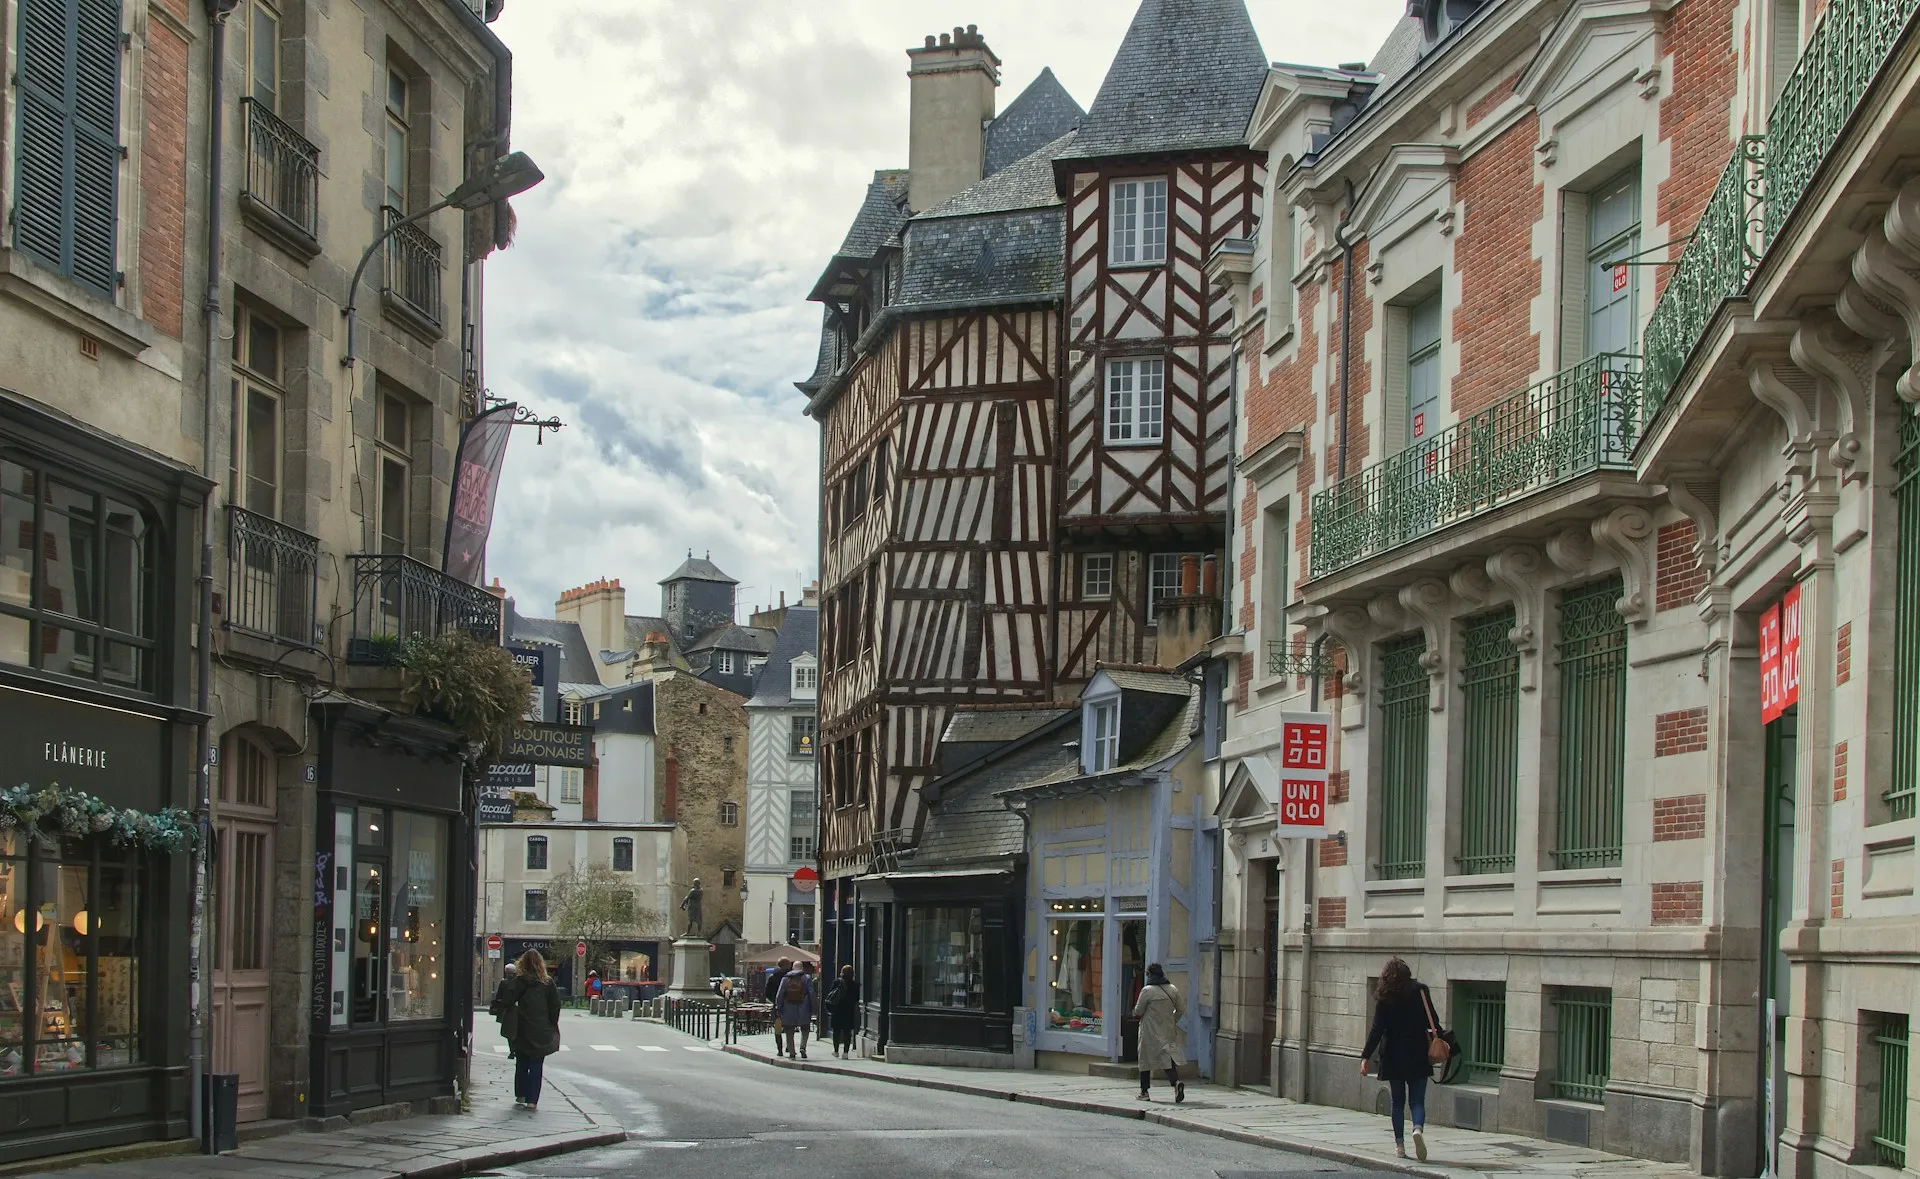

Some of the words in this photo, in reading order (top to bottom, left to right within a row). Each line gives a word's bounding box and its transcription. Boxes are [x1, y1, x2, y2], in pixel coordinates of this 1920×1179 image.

[513, 729, 582, 745] BOUTIQUE
[1289, 729, 1321, 745] ユニ
[45, 741, 106, 769] FLÂNERIE
[509, 743, 585, 760] JAPONAISE
[1288, 748, 1321, 764] クロ
[307, 766, 314, 781] 16
[488, 763, 531, 775] acadi
[1286, 784, 1318, 801] UNI
[1286, 802, 1320, 820] QLO
[1080, 1017, 1102, 1025] DRESS.COD
